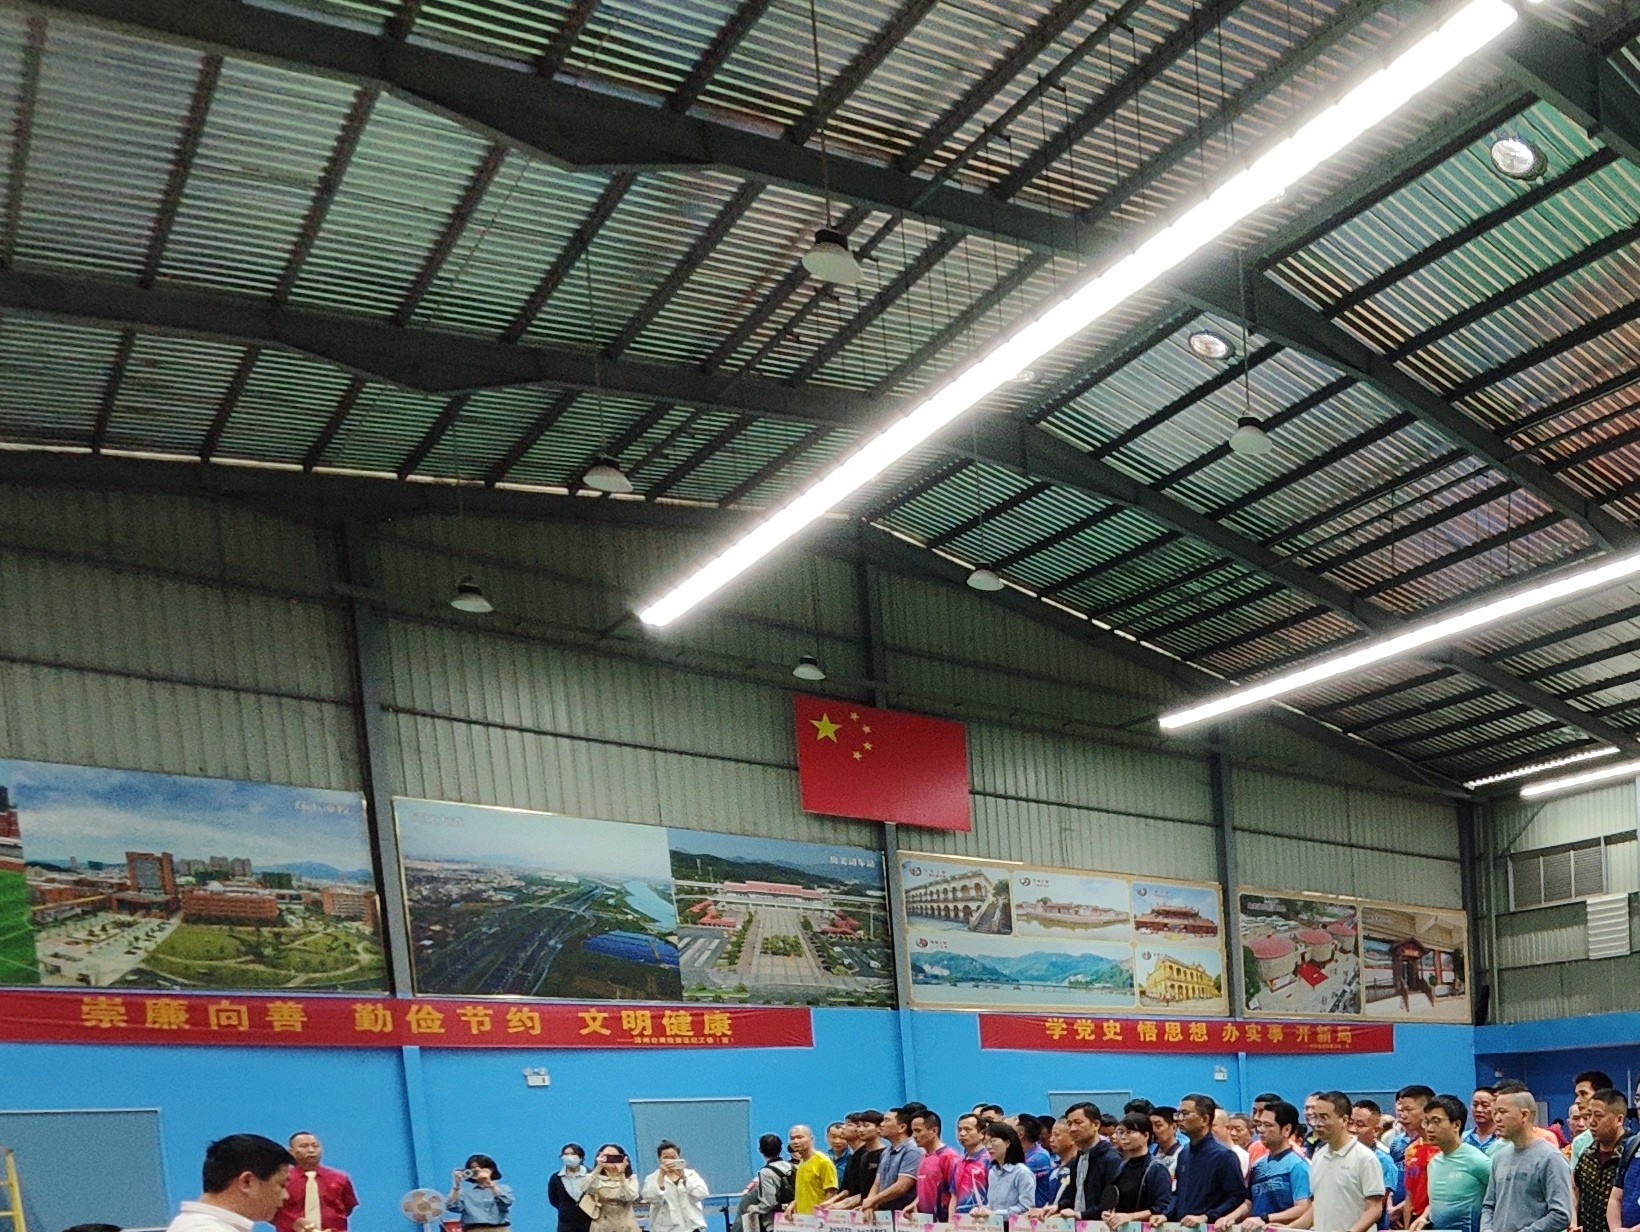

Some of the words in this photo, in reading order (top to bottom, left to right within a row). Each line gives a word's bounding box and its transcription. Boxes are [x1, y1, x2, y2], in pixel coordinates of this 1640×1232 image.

[81, 996, 308, 1033] 崇廉向善
[353, 1001, 543, 1037] 勤俭节约
[578, 1009, 733, 1038] 文明健康
[1045, 1017, 1123, 1042] 学党史
[1137, 1021, 1209, 1043] 悟思想
[1222, 1022, 1283, 1043] 办实事
[1296, 1024, 1352, 1044] 开新局
